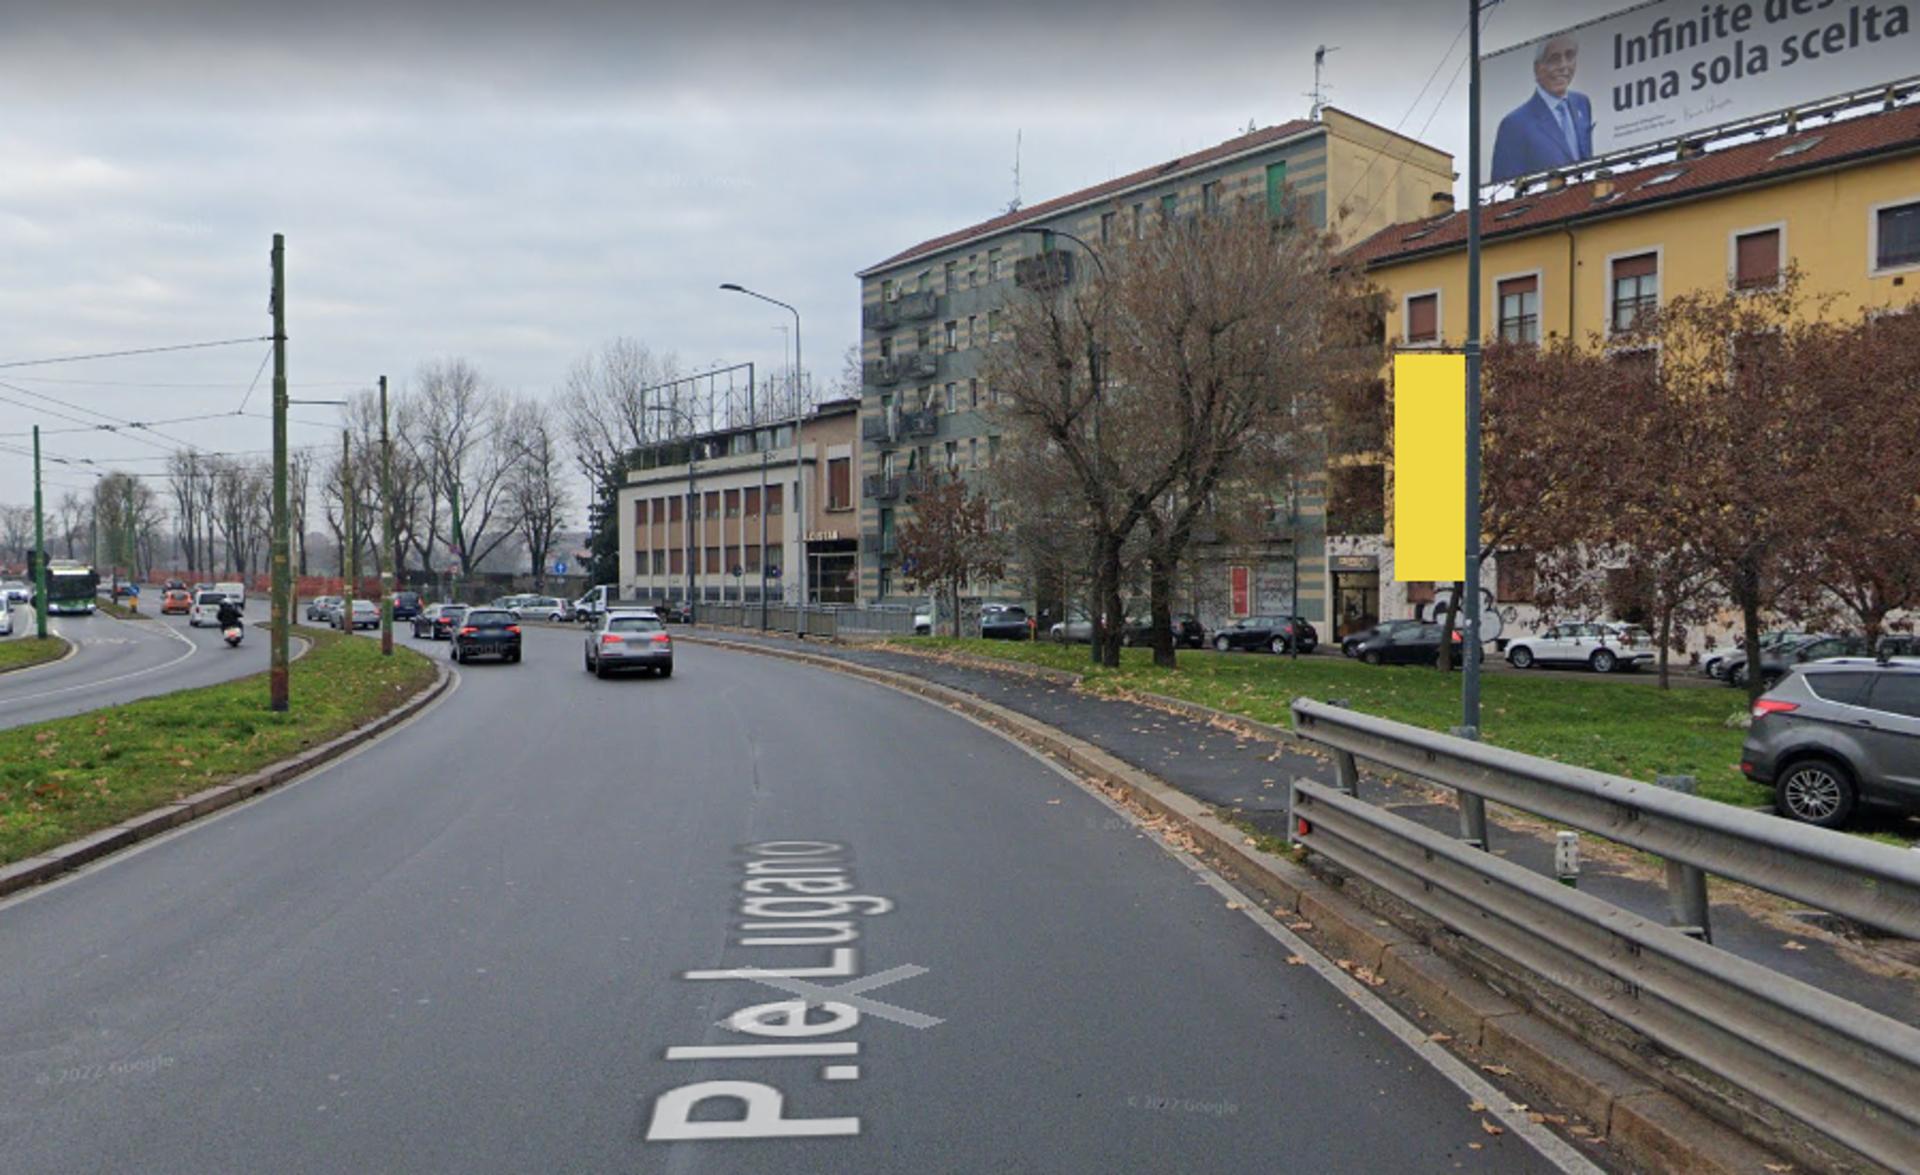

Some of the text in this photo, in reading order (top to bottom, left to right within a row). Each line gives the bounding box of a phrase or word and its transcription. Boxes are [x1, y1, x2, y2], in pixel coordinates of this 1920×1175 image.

[1613, 3, 1753, 70] Infinite
[1613, 69, 1680, 112] una
[1690, 39, 1769, 91] sola
[1780, 5, 1909, 67] scelta
